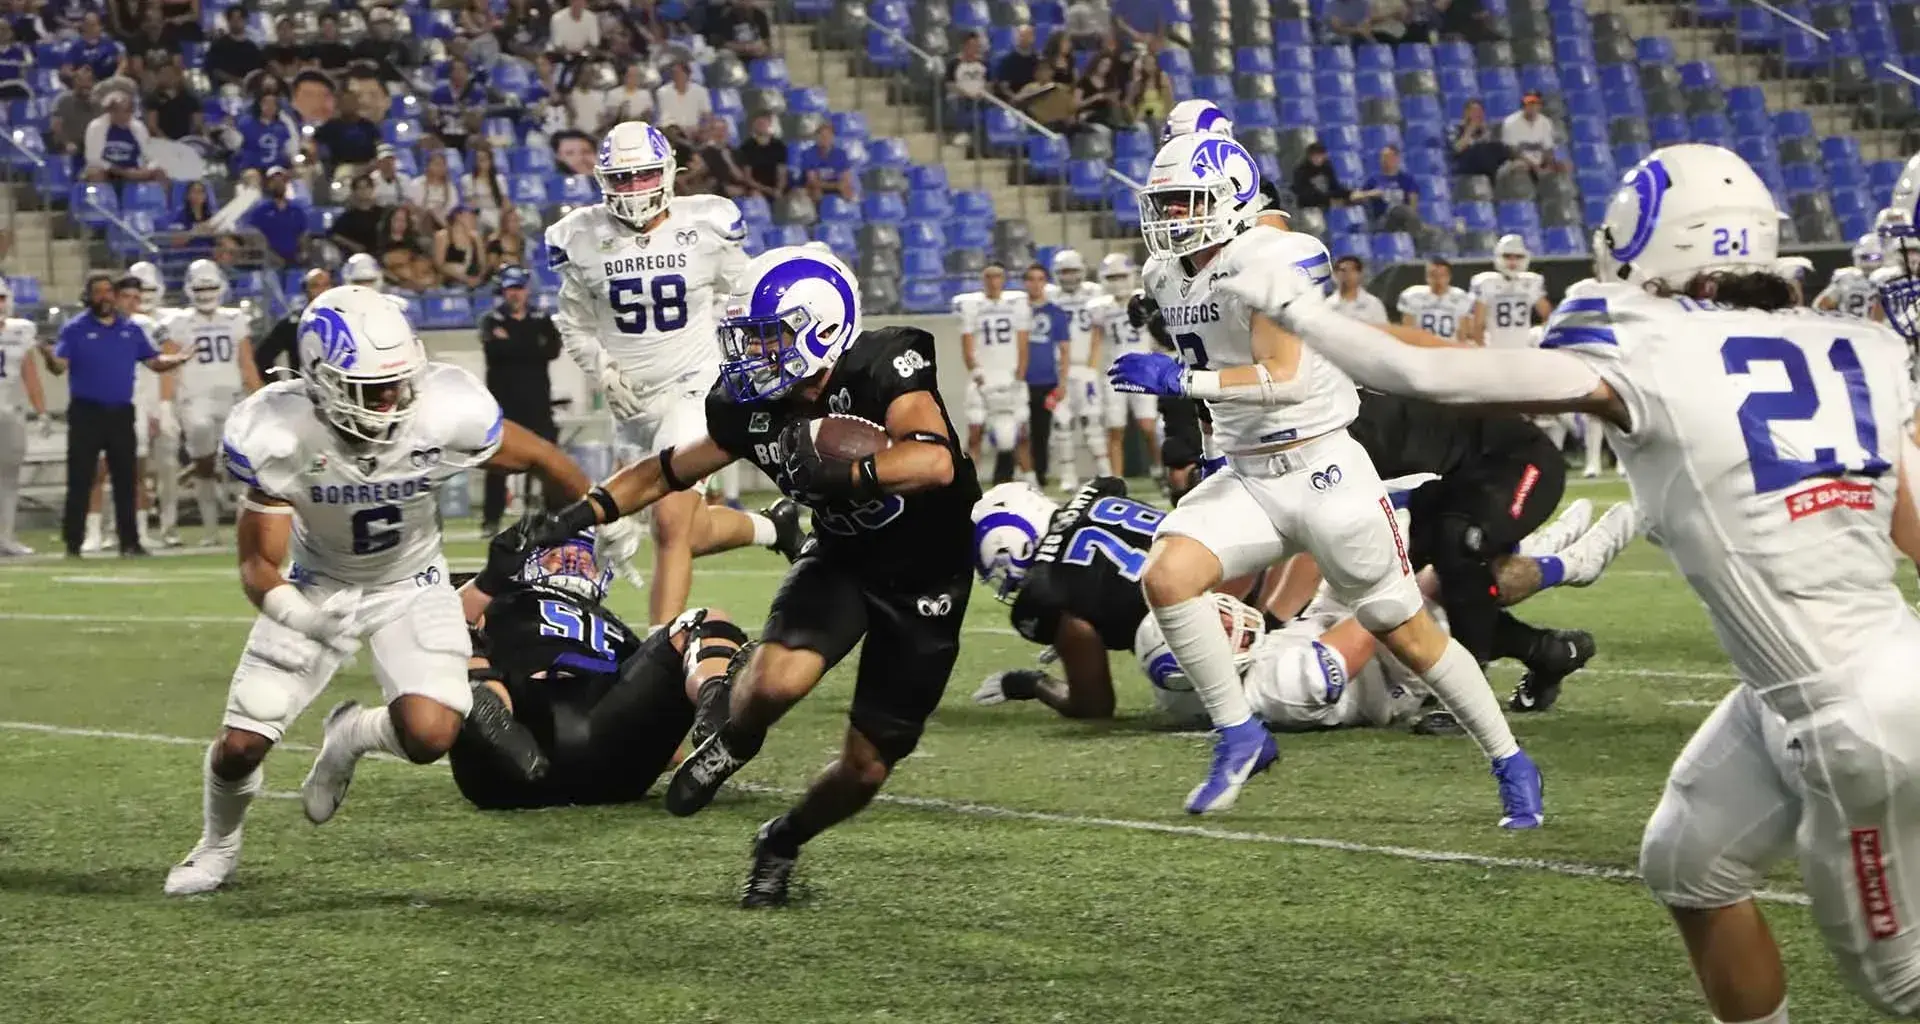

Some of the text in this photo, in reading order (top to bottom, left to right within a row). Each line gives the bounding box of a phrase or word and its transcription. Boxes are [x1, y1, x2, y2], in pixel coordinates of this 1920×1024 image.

[1714, 228, 1748, 256] 21
[604, 253, 687, 276] BORREGOS
[609, 274, 688, 334] 58
[1497, 301, 1528, 327] 83
[983, 318, 1011, 345] 12
[1720, 337, 1892, 494] 21
[311, 477, 430, 503] BORREGOS
[353, 504, 401, 555] 6
[1061, 496, 1167, 582] 78
